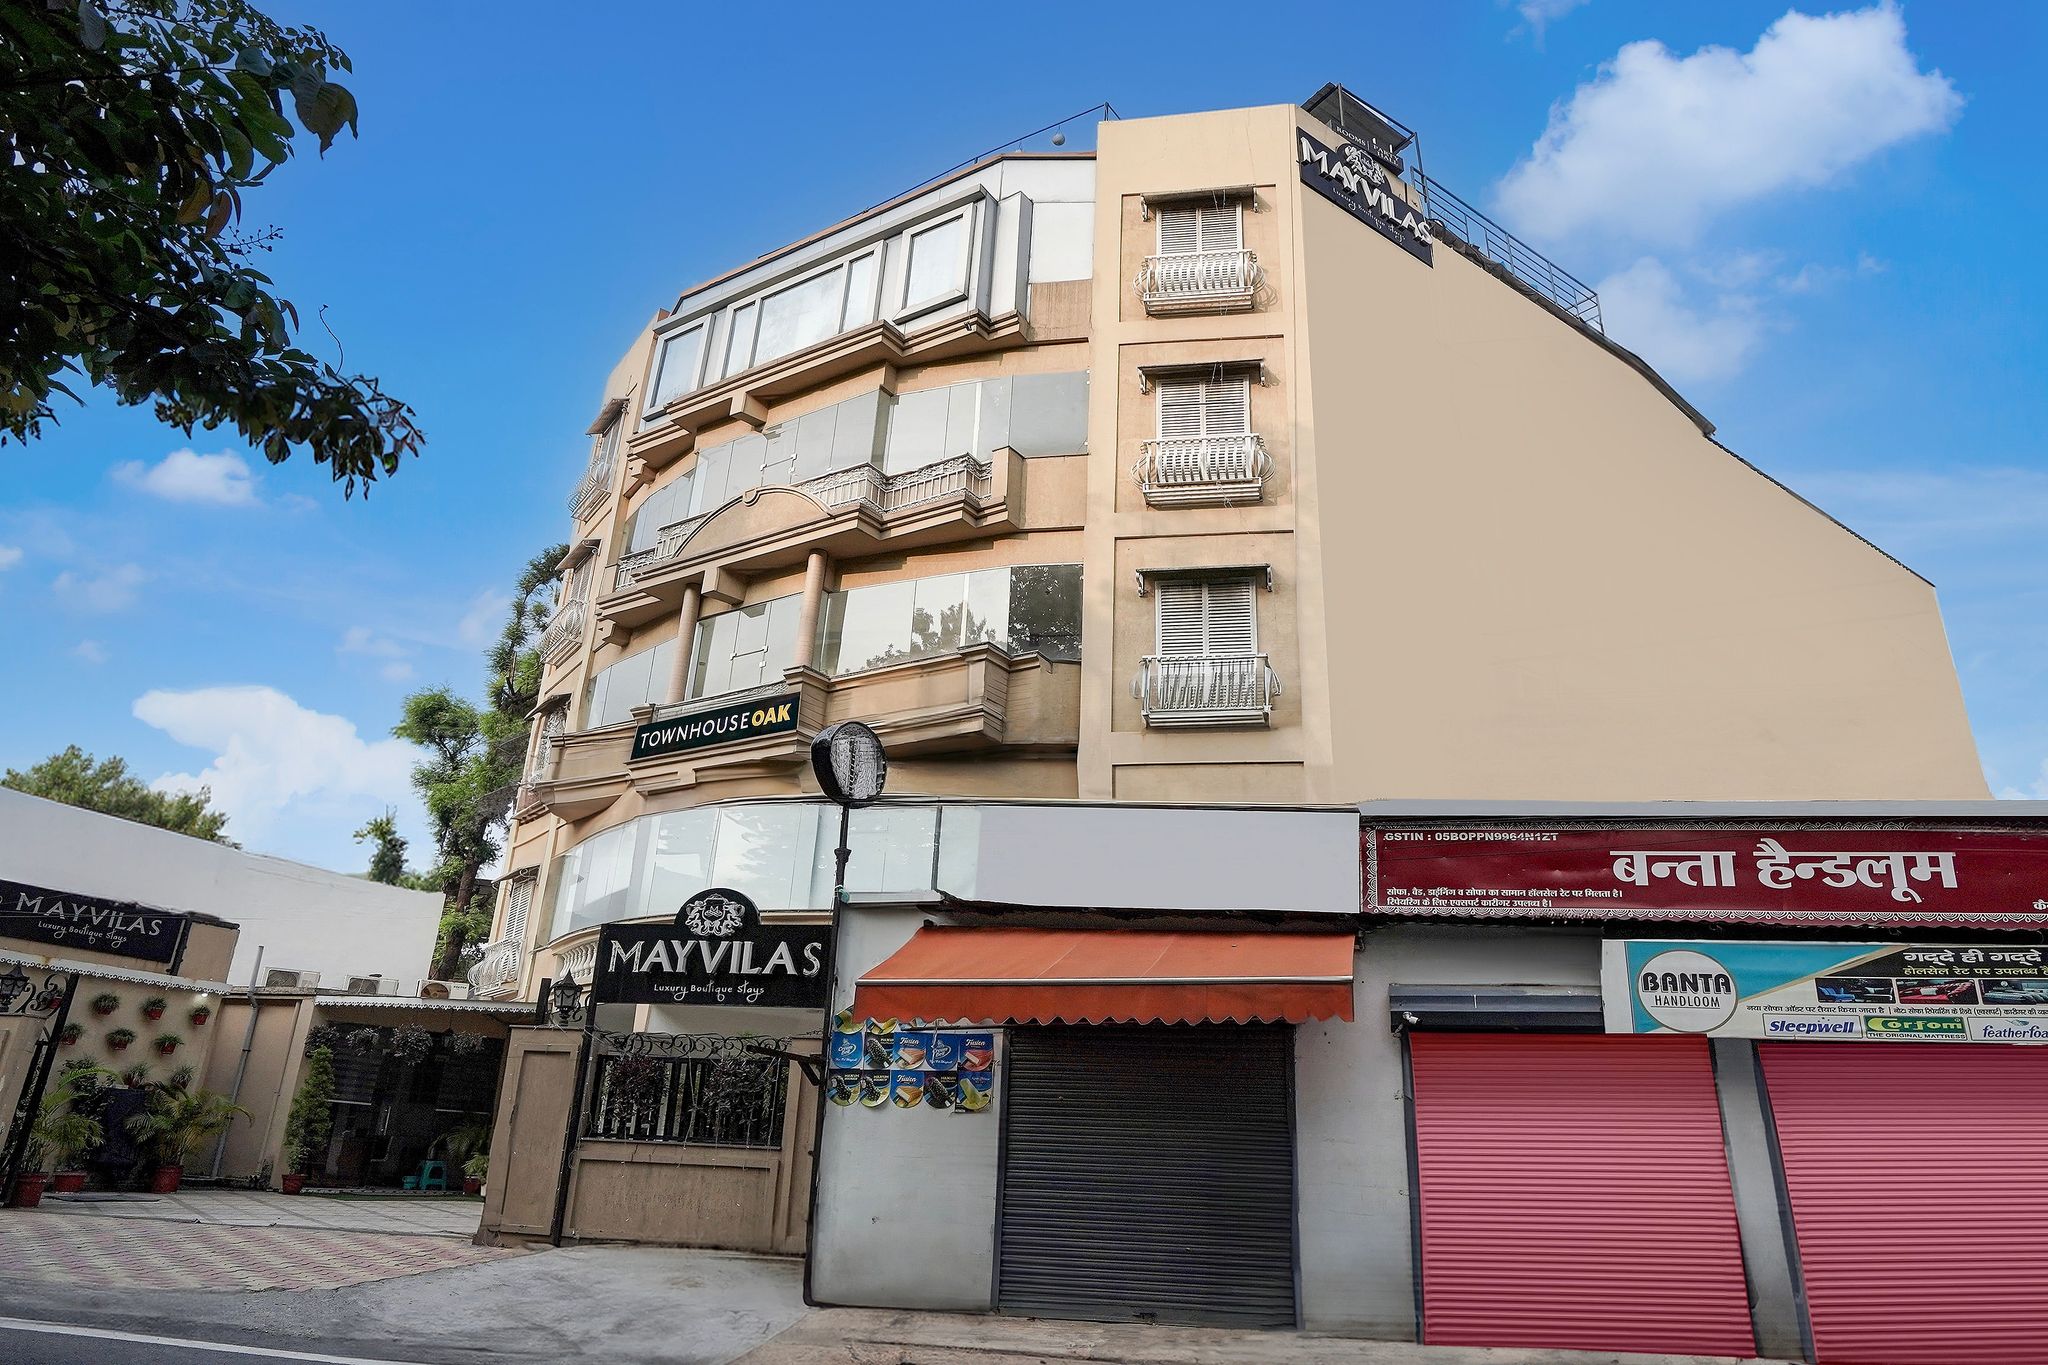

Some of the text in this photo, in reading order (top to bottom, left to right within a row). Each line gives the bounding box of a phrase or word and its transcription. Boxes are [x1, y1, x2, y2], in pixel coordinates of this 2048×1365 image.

[1336, 125, 1366, 146] ROOMS
[1301, 136, 1433, 247] MAYVILAS
[641, 703, 792, 749] TOWNHOUSE OAK
[1385, 832, 1425, 841] GSTIN
[1610, 837, 1959, 904] बन्ता हैन्डलूम
[1422, 898, 1431, 906] के
[1465, 887, 1487, 896] सोफा
[1488, 888, 1499, 896] का
[1501, 889, 1526, 897] सामान
[1559, 888, 1570, 897] रेट
[1572, 889, 1583, 897] पर
[1585, 888, 1611, 897] मिलता
[16, 892, 163, 936] MAYVILAS
[38, 920, 127, 948] Luxury Boutique Stays
[608, 939, 822, 977] MAYVILAS
[1959, 949, 1985, 963] ही
[1902, 966, 1949, 976] होलसेल
[1953, 966, 1971, 976] रेट
[1974, 967, 1991, 976] पर
[1993, 967, 2039, 976] उपलब्ध
[654, 980, 765, 1003] Luxury Boutique Stays
[1641, 972, 1732, 995] BANTA
[1654, 995, 1721, 1007] HANDLOOM
[1838, 1005, 1857, 1013] किया
[1769, 1020, 1855, 1035] Sleepwell
